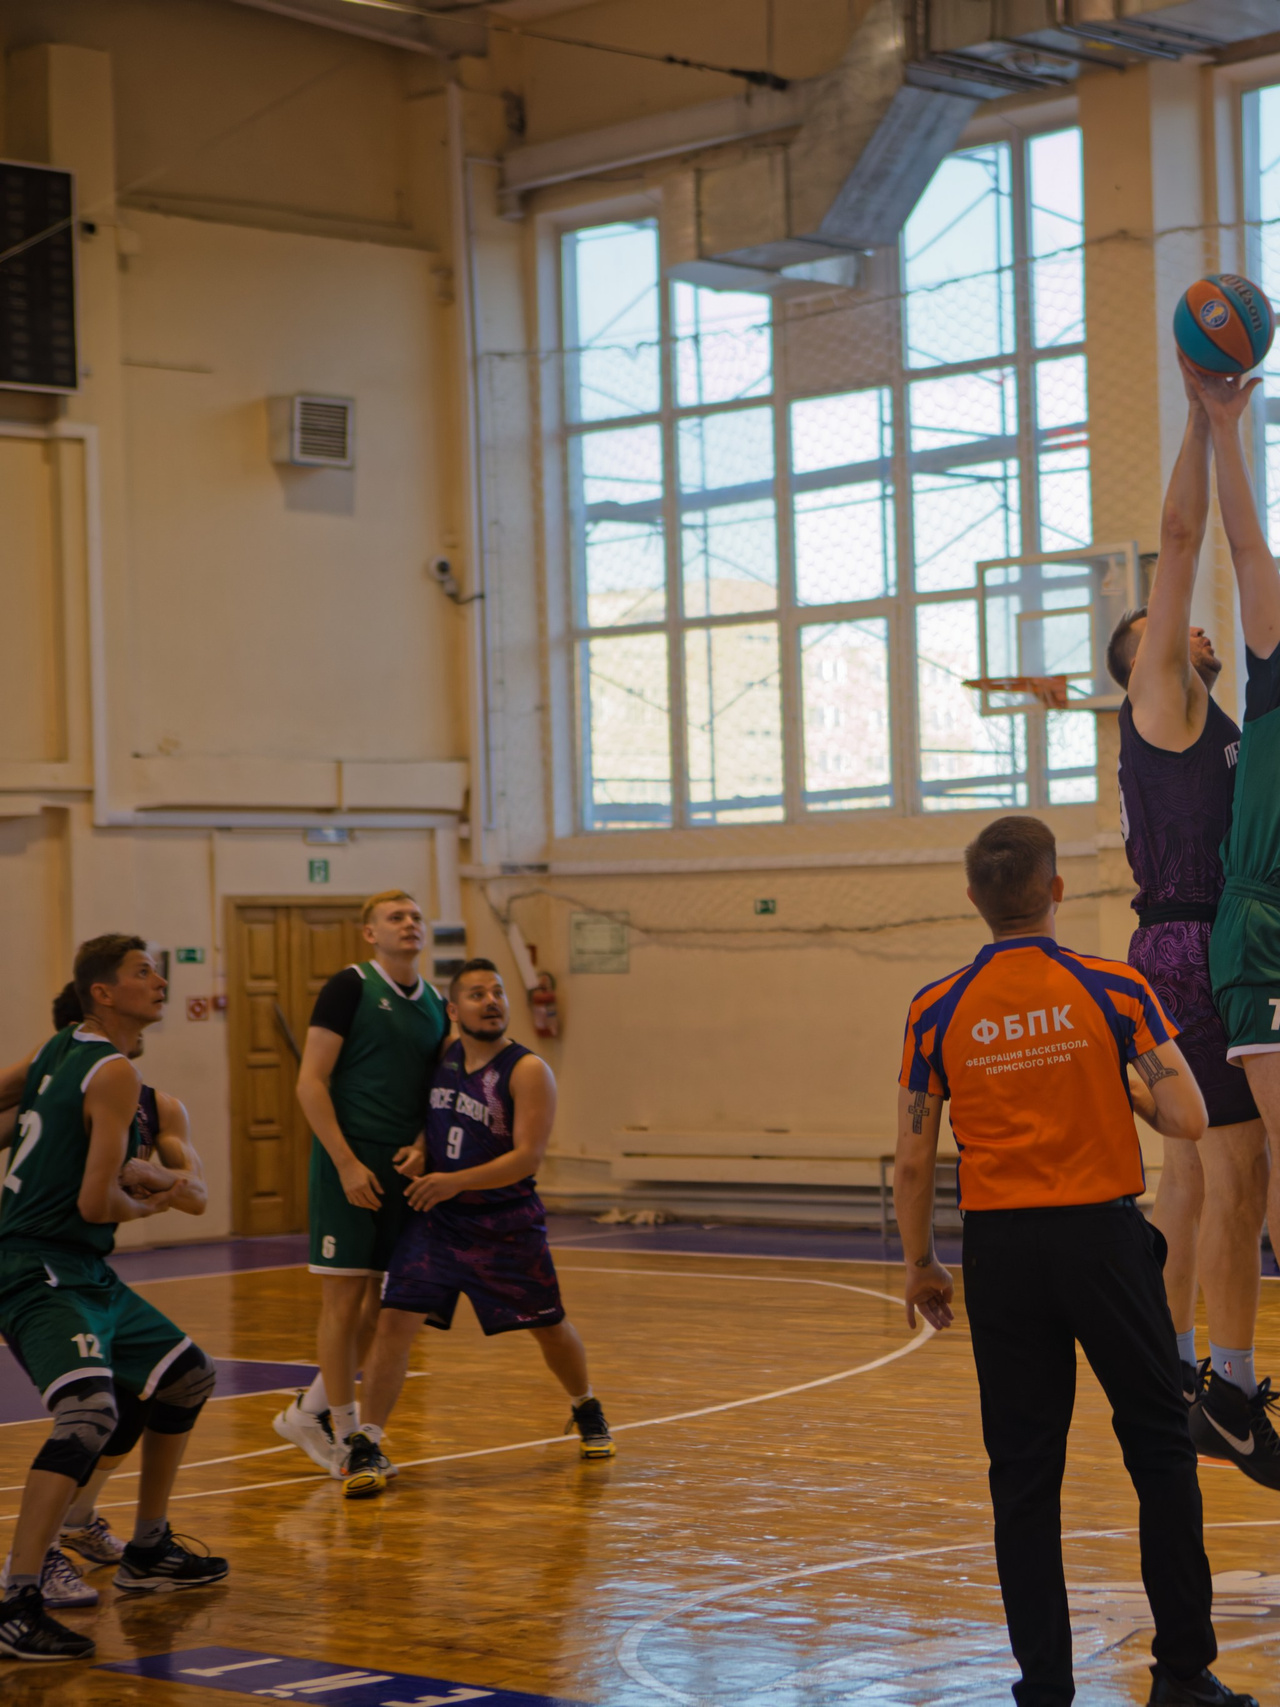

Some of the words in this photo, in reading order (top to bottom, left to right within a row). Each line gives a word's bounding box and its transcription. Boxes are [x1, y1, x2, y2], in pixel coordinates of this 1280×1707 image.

[1218, 275, 1263, 332] Wilson
[1223, 740, 1240, 769] ПЕ
[971, 1004, 1075, 1045] ФБПК
[965, 1050, 1023, 1067] ФЕДЕРАЦИЯ
[1025, 1039, 1089, 1057] БАСКЕТБОЛА
[986, 1058, 1044, 1075] ПЕРМСКОГО
[1047, 1053, 1072, 1066] КРАЯ
[446, 1125, 464, 1160] 9
[321, 1234, 337, 1259] 6
[70, 1333, 104, 1359] 12
